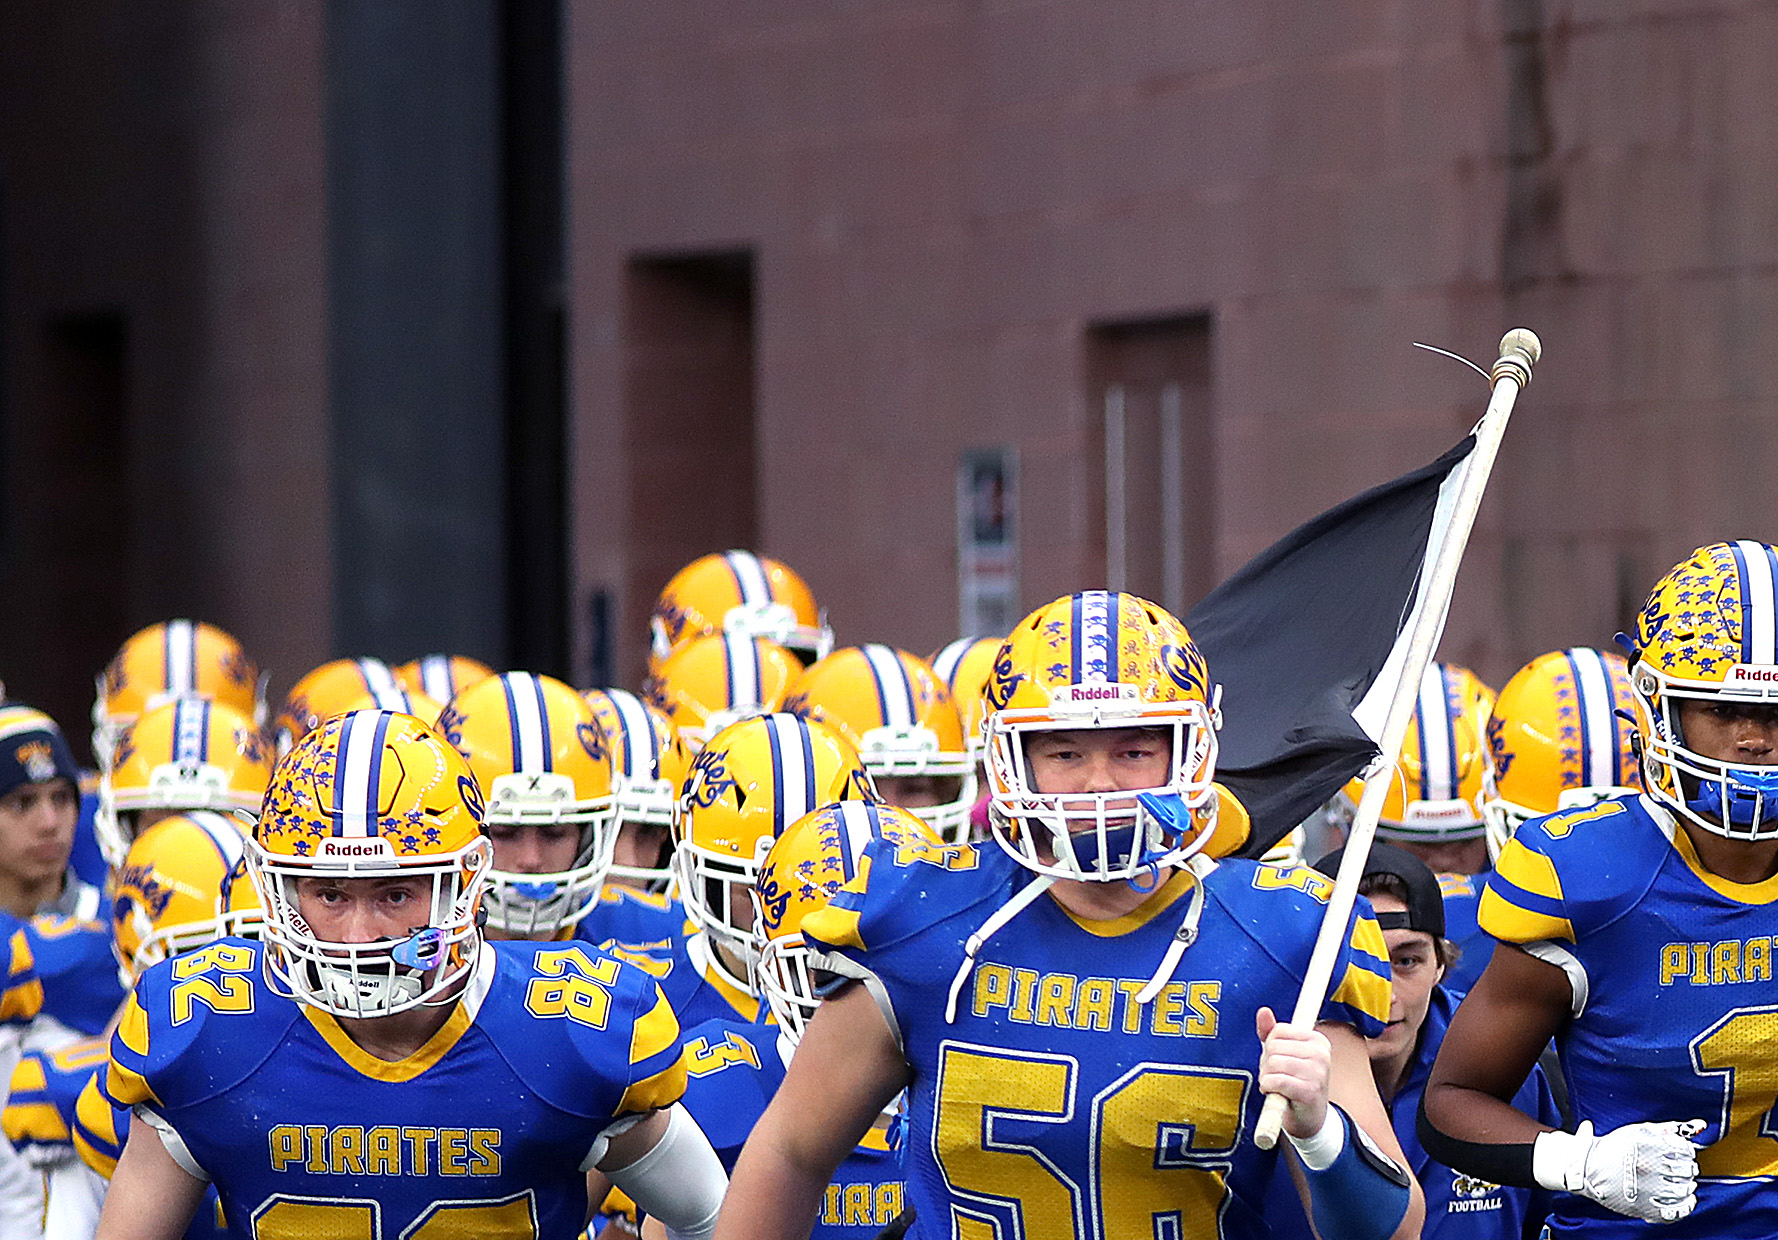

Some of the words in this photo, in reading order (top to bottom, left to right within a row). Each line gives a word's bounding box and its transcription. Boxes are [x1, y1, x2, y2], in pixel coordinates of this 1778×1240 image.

[1071, 686, 1119, 701] Riddell
[1540, 800, 1628, 840] 1
[325, 843, 384, 857] Riddell
[170, 943, 256, 1027] 82
[524, 946, 623, 1031] 82
[972, 961, 1223, 1039] PIRATES
[268, 1123, 502, 1177] PIRATES
[1448, 1197, 1503, 1213] FOOTBALL
